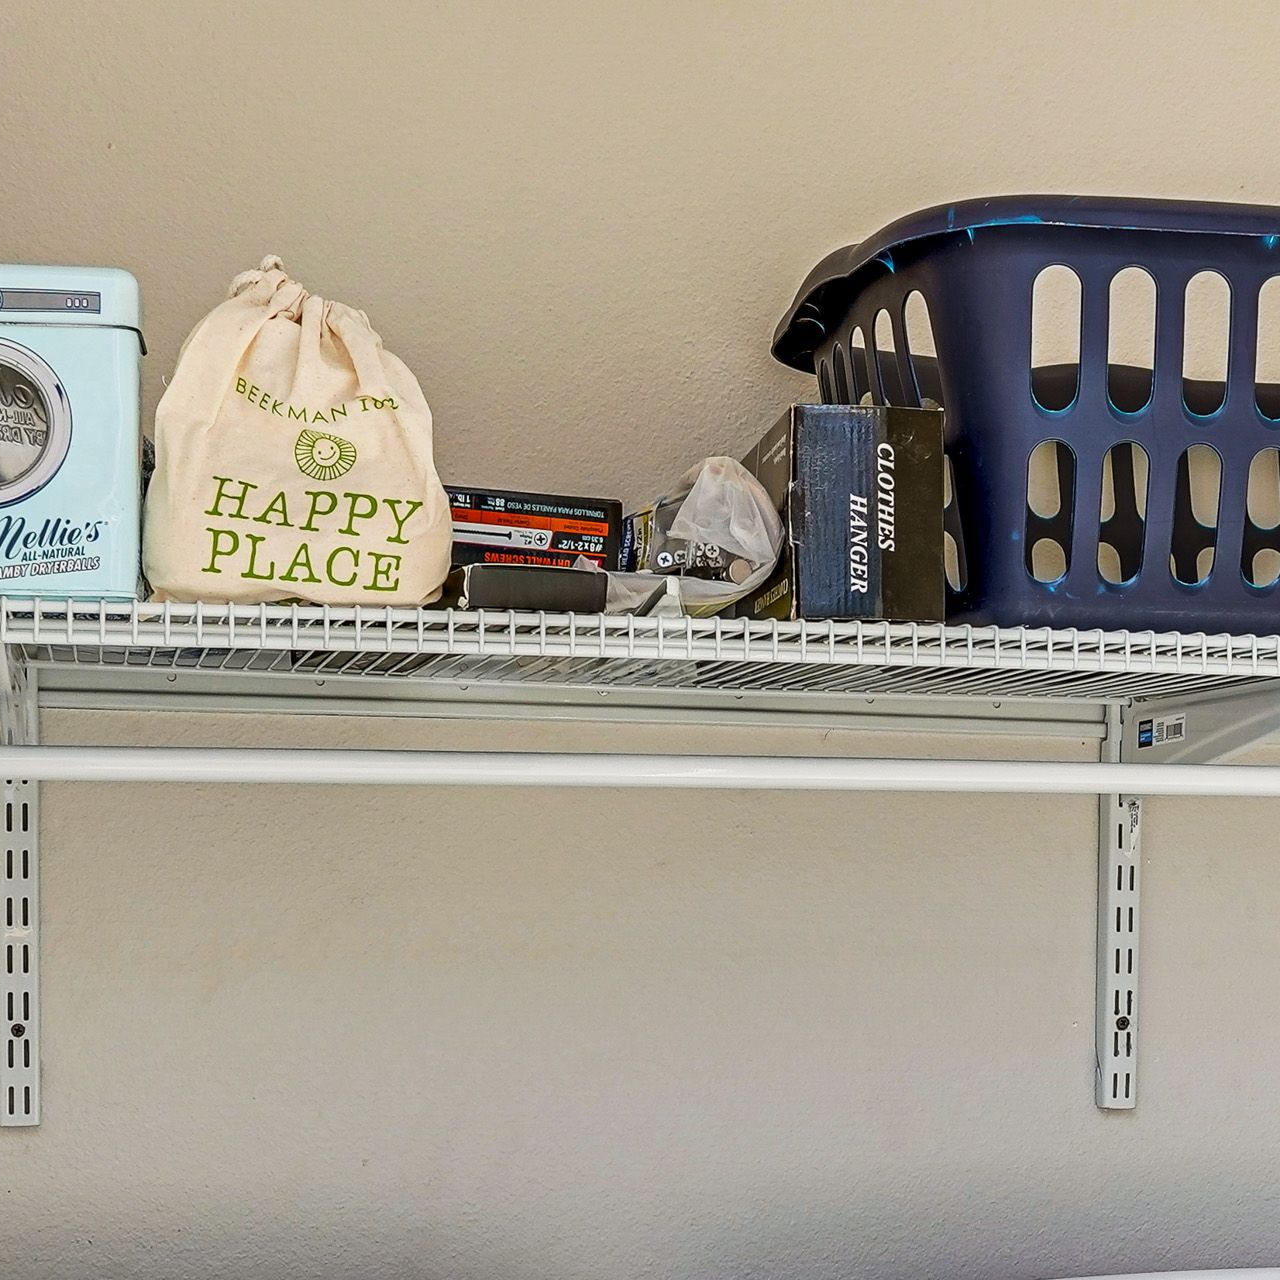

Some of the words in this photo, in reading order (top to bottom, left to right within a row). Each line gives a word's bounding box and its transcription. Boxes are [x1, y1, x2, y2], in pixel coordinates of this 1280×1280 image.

[235, 375, 349, 424] BEEKMAN
[495, 497, 505, 507] 88
[877, 442, 895, 552] CLOTHES
[204, 475, 423, 545] HAPPY
[506, 501, 522, 510] YESO
[522, 502, 531, 511] DE
[532, 503, 557, 513] PANELES
[557, 506, 574, 516] PARA
[574, 508, 605, 518] TORNILLOS
[850, 493, 868, 594] HANGER
[21, 546, 85, 562] ALL-NATURAL
[201, 527, 402, 592] PLACE
[484, 551, 525, 564] SCREWS
[30, 556, 101, 577] DRYERBALLS
